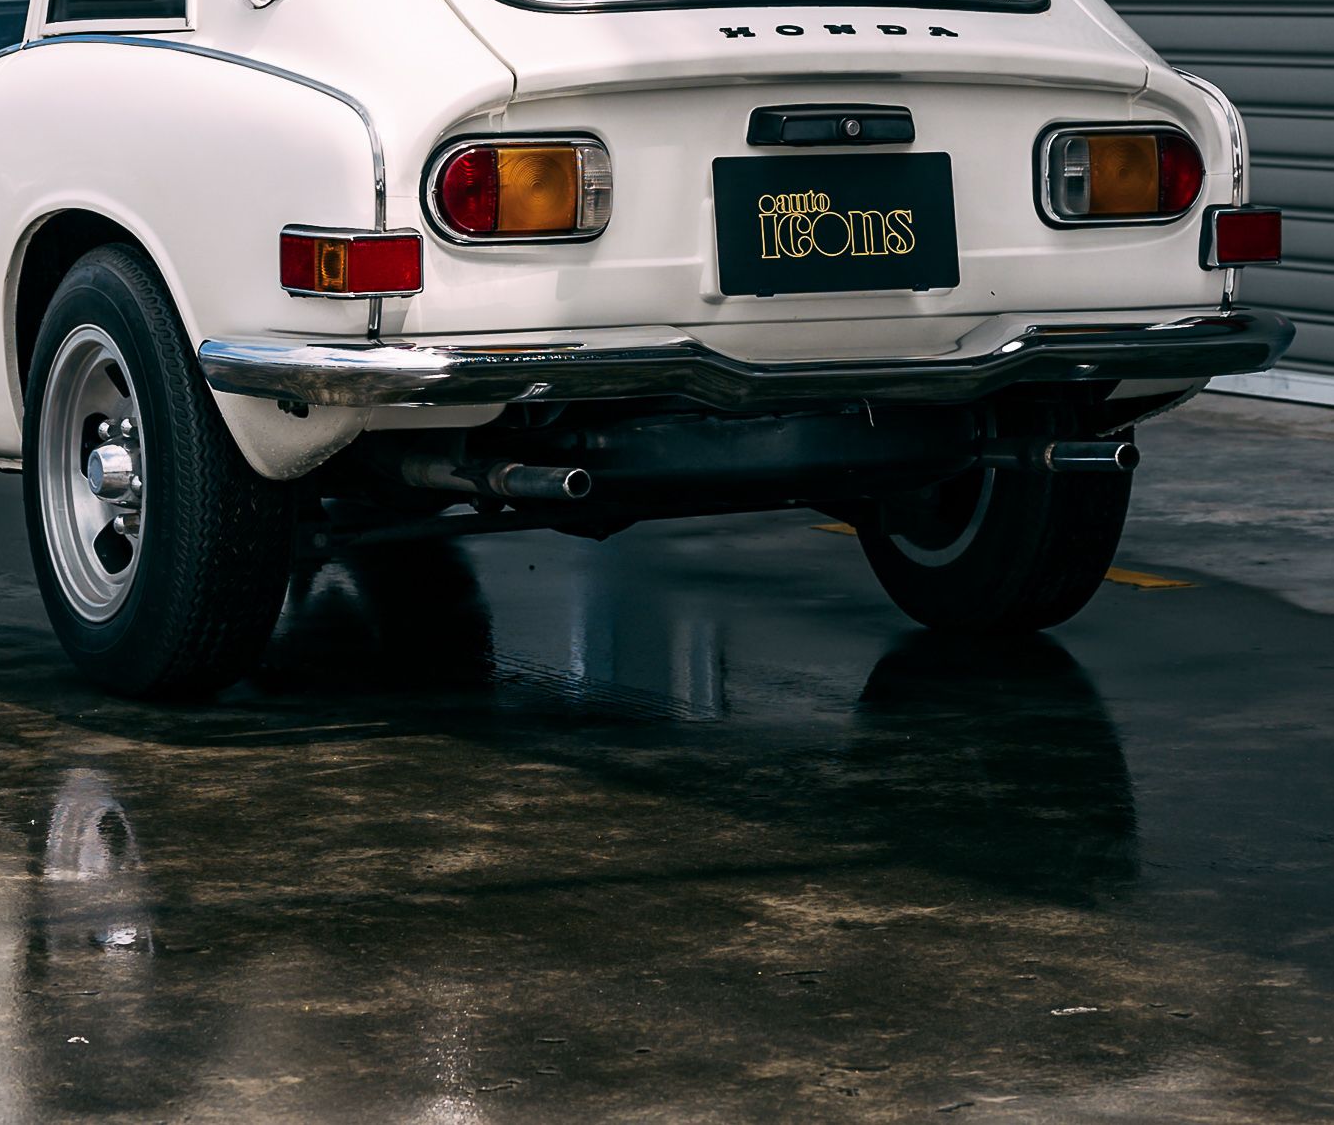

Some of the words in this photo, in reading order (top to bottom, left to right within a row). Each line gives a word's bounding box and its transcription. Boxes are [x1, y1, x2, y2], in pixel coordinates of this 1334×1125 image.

[719, 24, 959, 38] HONDA
[775, 189, 830, 213] auto
[758, 195, 916, 259] icons
